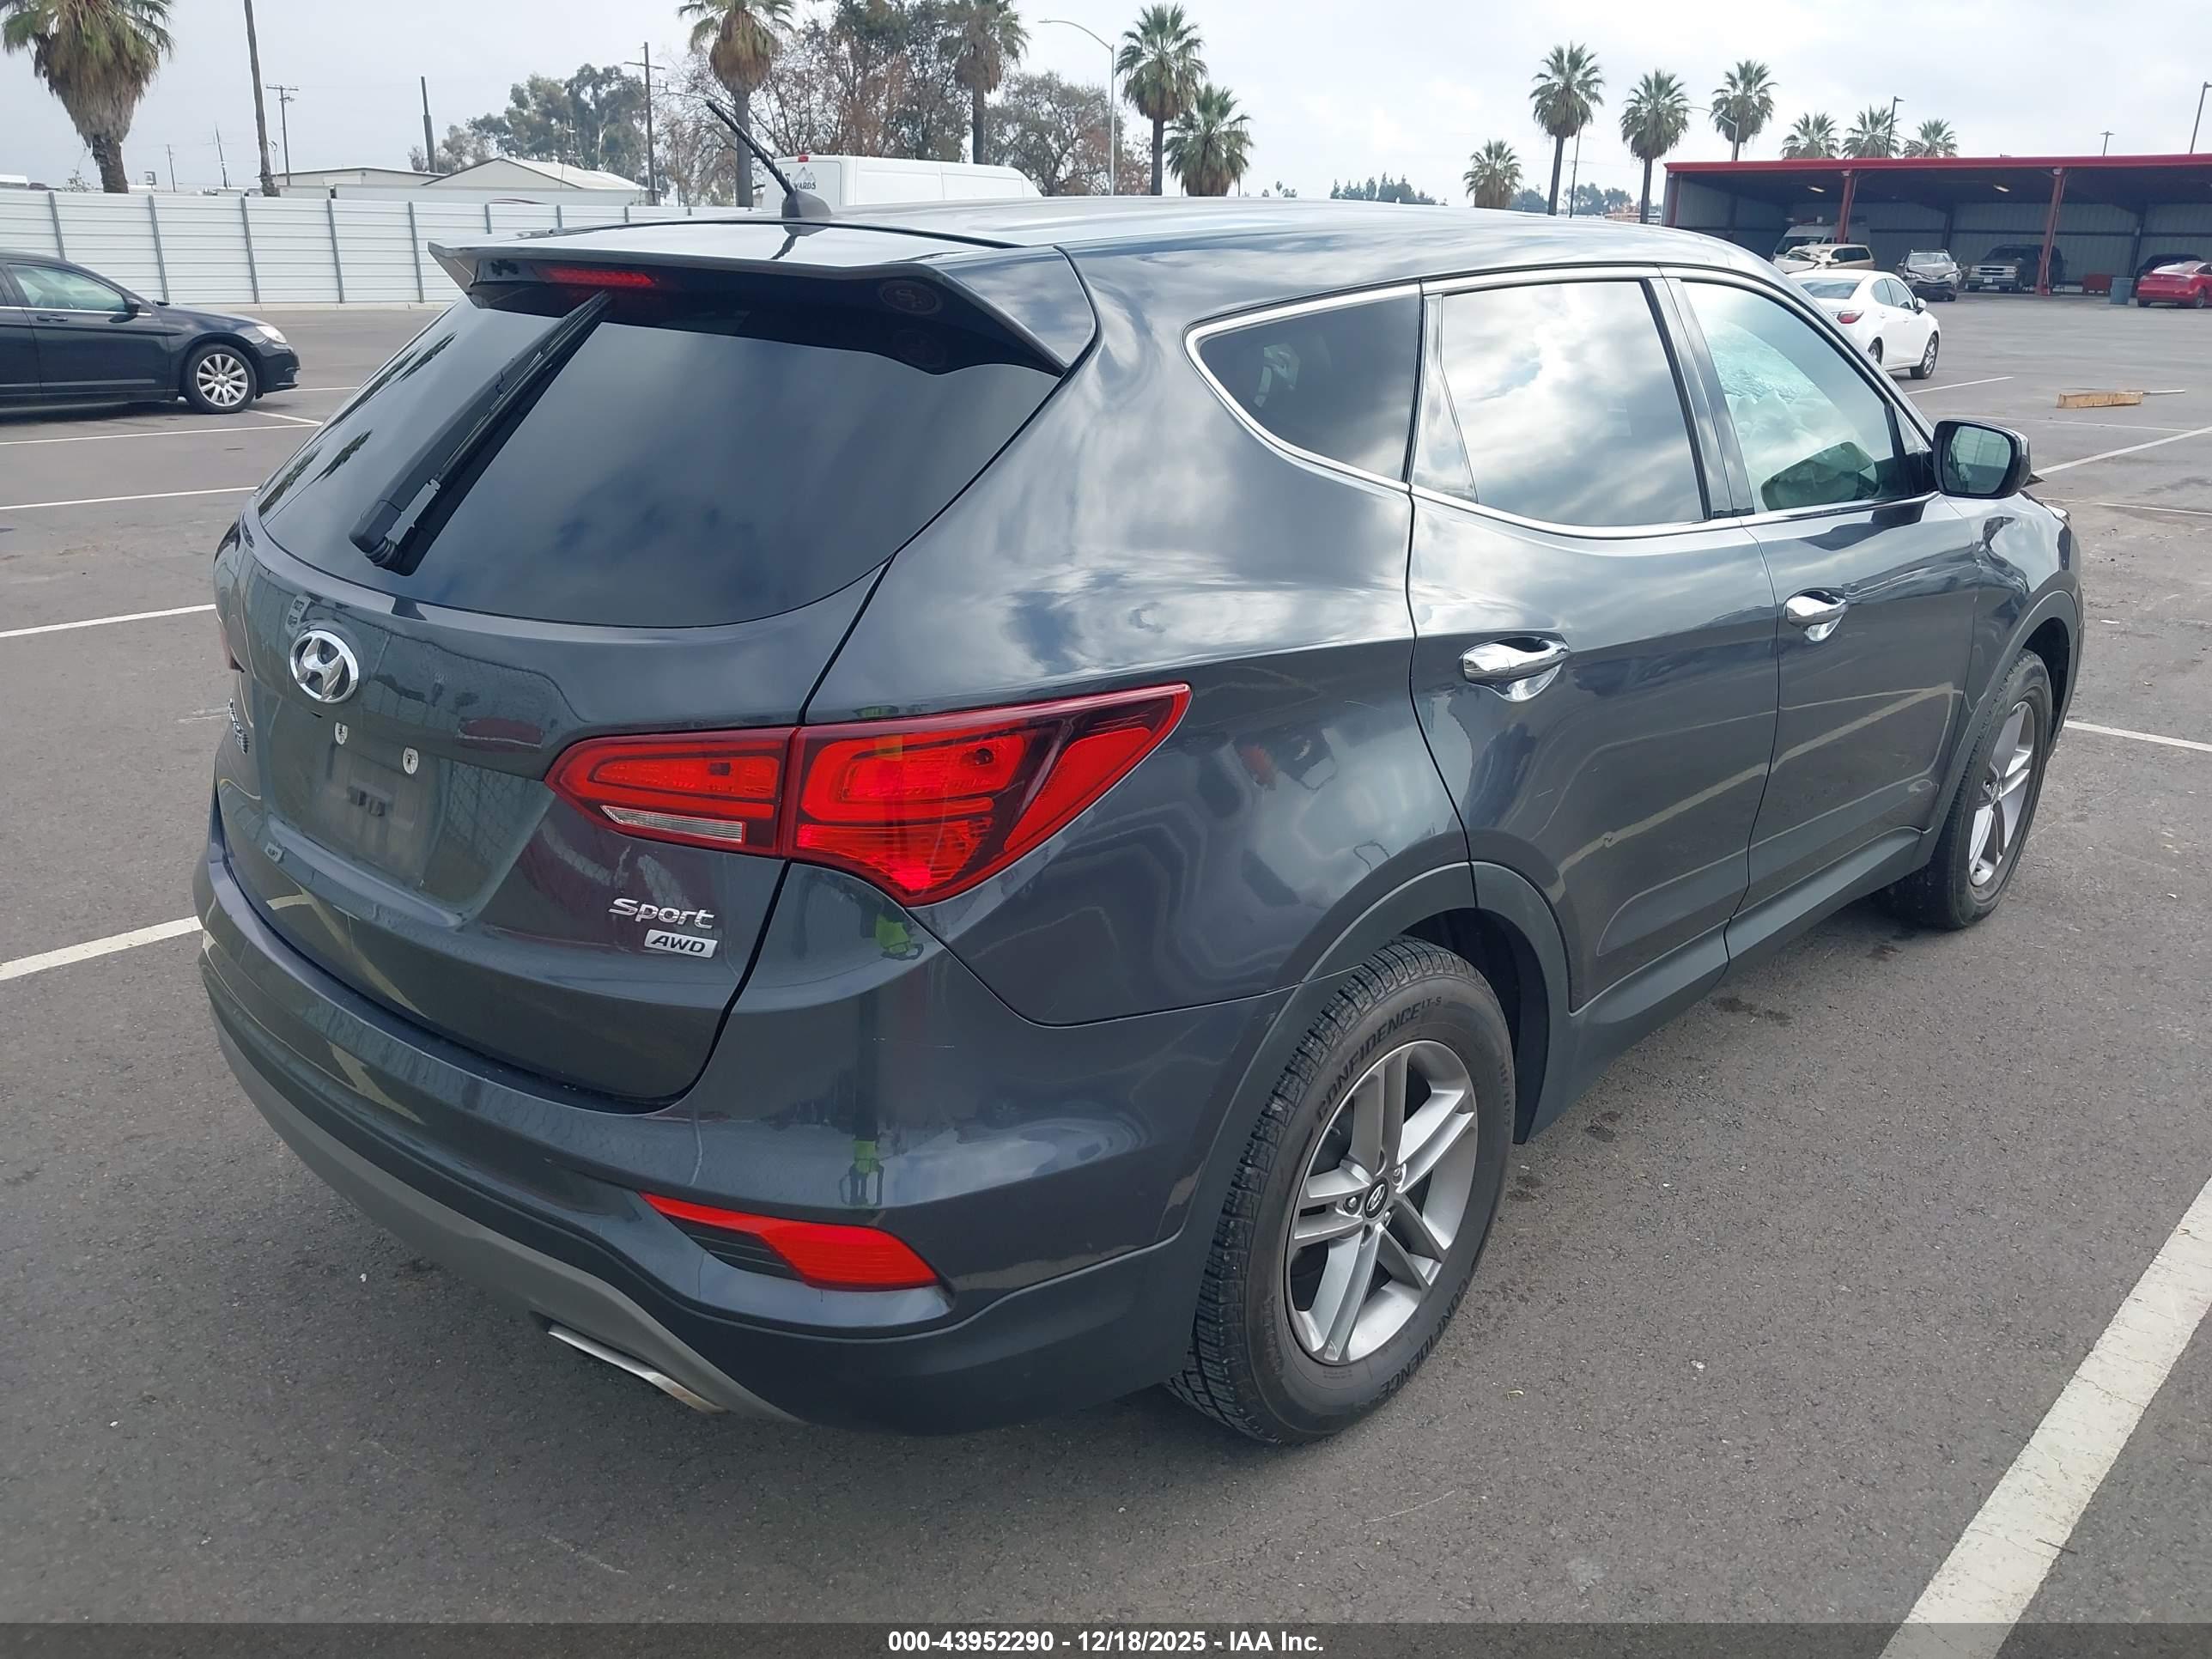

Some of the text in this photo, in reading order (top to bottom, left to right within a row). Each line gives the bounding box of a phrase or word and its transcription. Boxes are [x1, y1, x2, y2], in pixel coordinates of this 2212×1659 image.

[608, 897, 715, 930] Sport
[650, 934, 706, 953] AWD
[1316, 1001, 1421, 1123] CONFIDENCE
